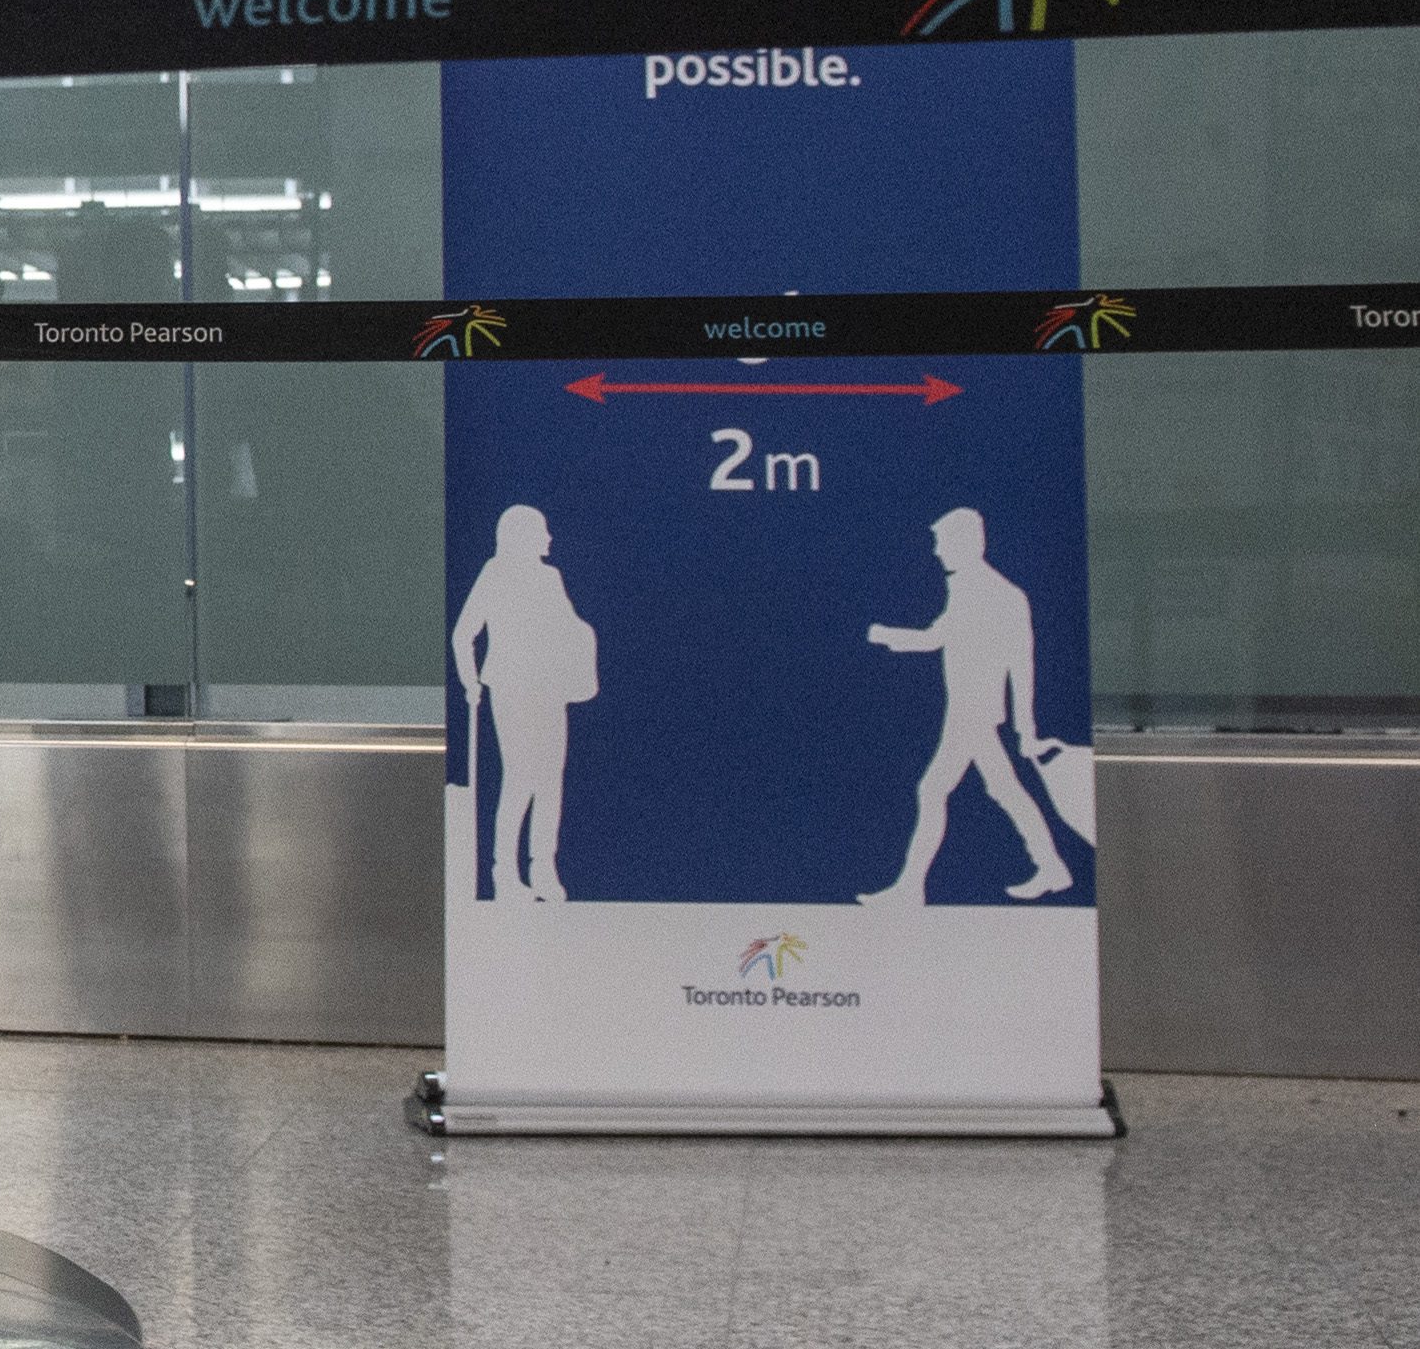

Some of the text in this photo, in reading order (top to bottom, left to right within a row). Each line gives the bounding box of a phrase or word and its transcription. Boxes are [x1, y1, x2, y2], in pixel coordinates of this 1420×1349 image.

[646, 48, 860, 98] possible.
[1351, 306, 1420, 327] Toron
[35, 323, 222, 342] Toronto Pearson
[705, 317, 825, 338] welcome
[681, 985, 860, 1007] Toronto Pearson
